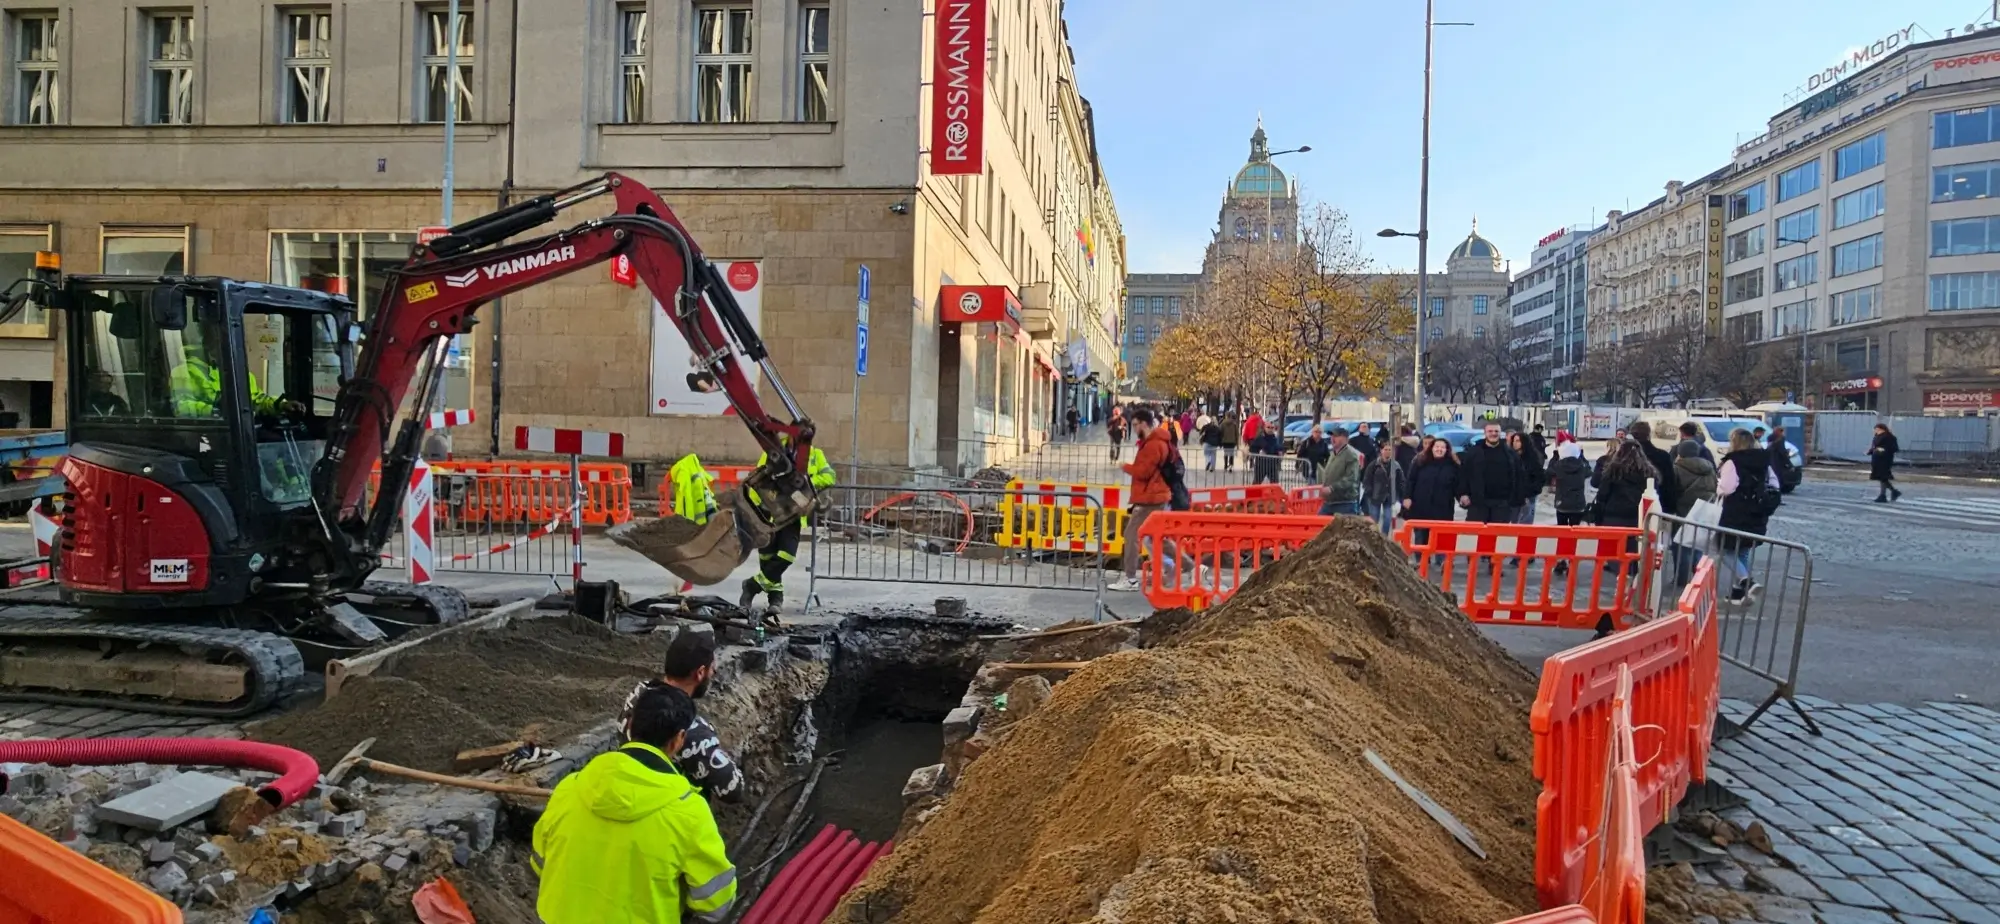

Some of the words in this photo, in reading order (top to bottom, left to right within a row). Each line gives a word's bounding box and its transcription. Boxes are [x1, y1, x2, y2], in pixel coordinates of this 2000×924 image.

[945, 3, 971, 161] ROSSMANN
[482, 245, 575, 280] YANMAR
[153, 564, 185, 573] MKM
